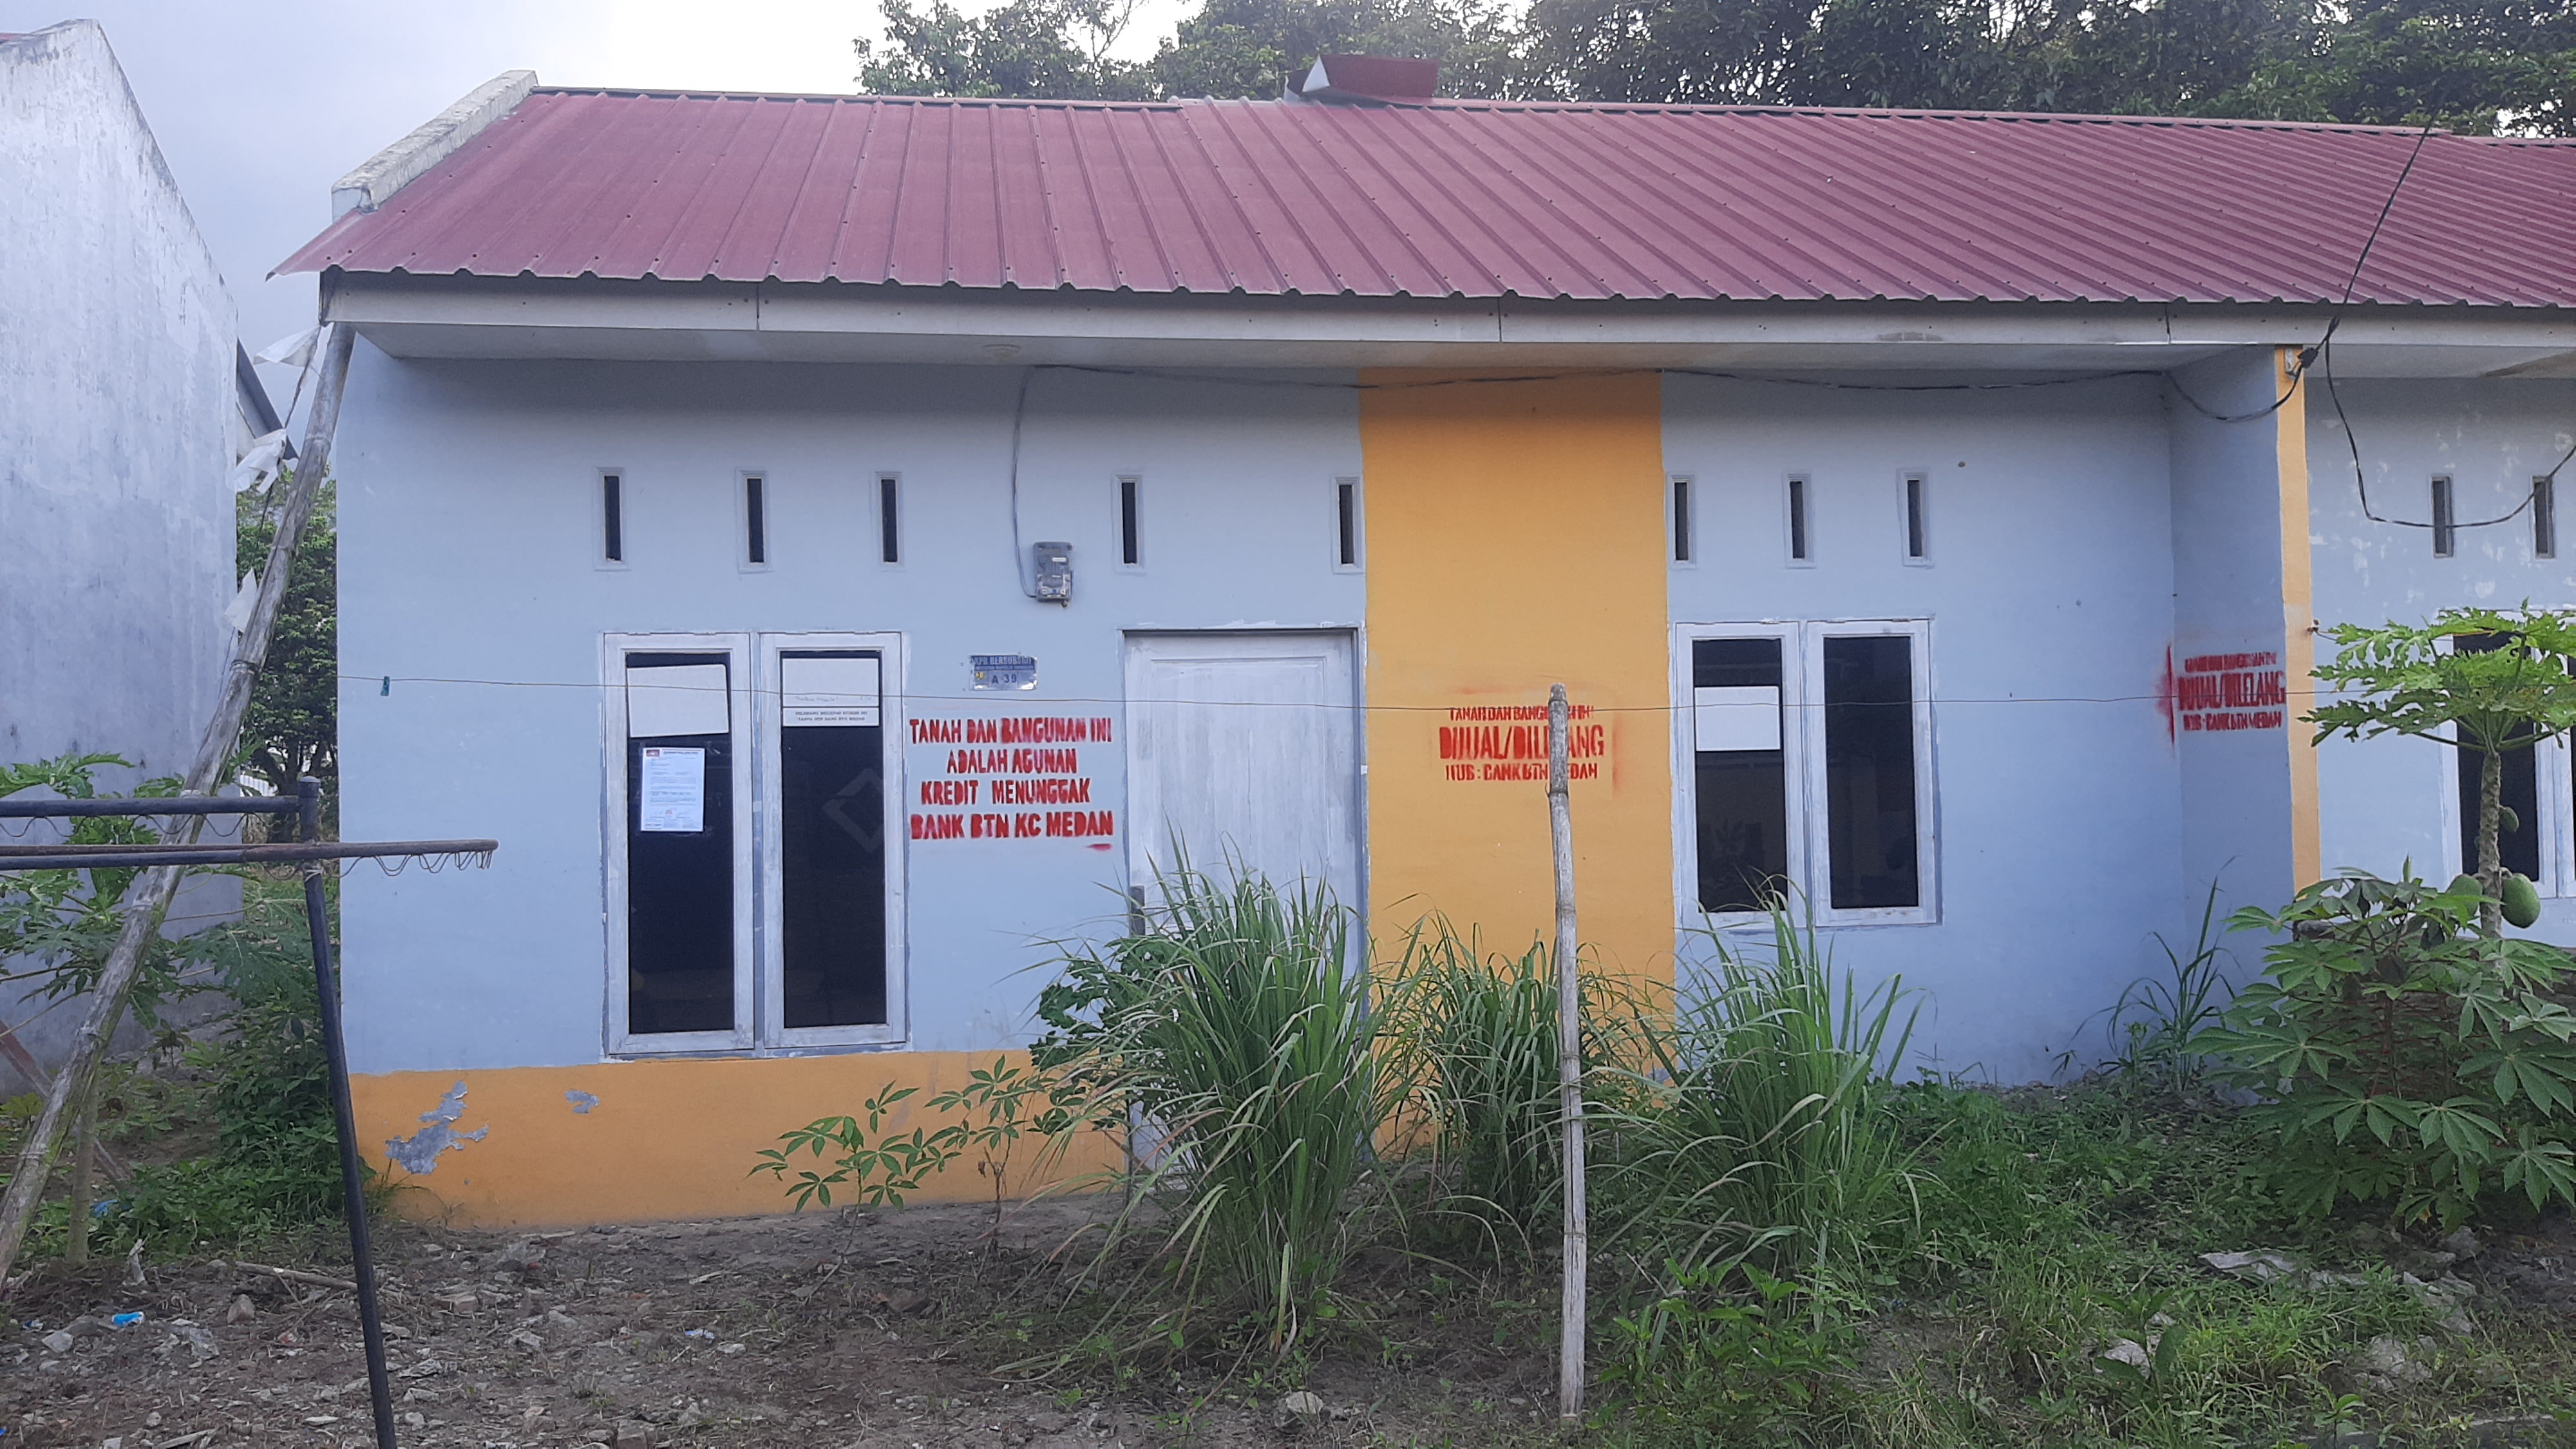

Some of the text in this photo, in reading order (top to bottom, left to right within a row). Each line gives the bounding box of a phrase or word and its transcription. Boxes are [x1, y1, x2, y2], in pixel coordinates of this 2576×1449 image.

[1450, 706, 1486, 721] TANAH
[1488, 706, 1511, 721] DAN
[910, 717, 1112, 744] TANAH DAN BANGUNAN INI
[947, 748, 1077, 773] ADALAH AGUNAN
[922, 778, 1090, 804] KREDIT MENUNGGAK
[910, 811, 1113, 839] BANK BTN KC MEDAN
